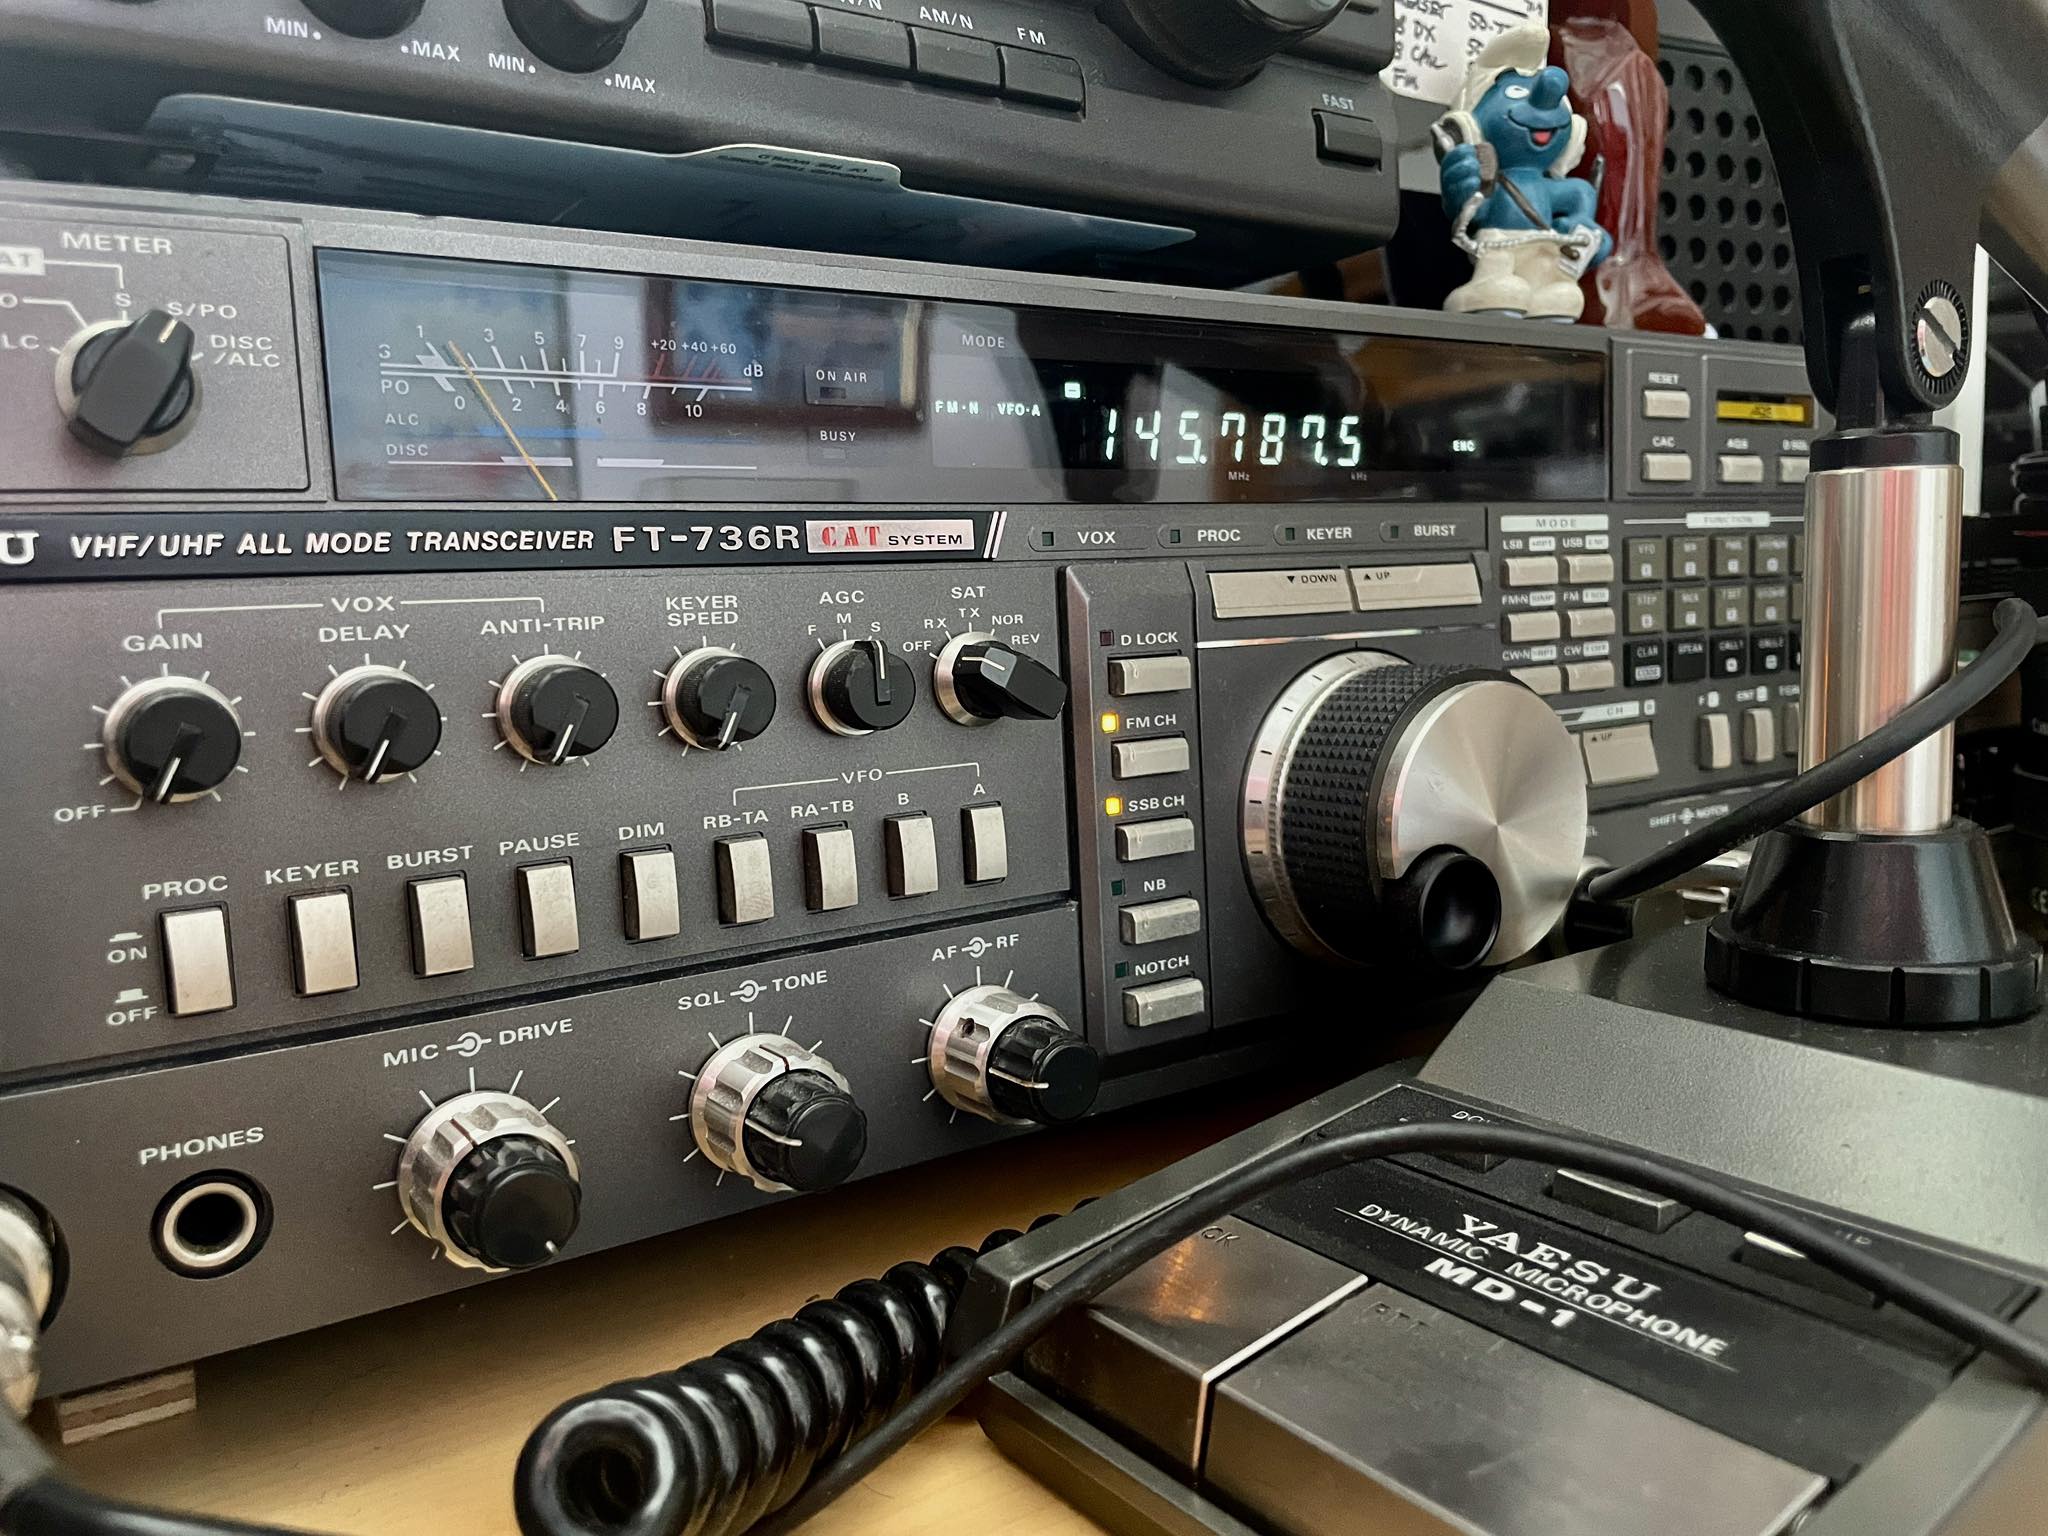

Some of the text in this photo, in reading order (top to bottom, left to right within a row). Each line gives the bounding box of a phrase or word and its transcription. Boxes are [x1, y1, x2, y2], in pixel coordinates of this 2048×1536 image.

[919, 6, 974, 31] AM/N
[265, 16, 309, 38] MIN
[1016, 27, 1046, 46] FM
[412, 40, 460, 62] MAX
[488, 53, 525, 73] MIN
[614, 74, 656, 95] MAX
[1322, 93, 1354, 112] FAST
[61, 231, 174, 255] METER
[116, 292, 132, 307] S
[167, 301, 237, 319] S/PO
[210, 334, 273, 350] DISC
[961, 333, 1005, 348] MODE
[416, 324, 424, 338] 1
[483, 328, 495, 342] 3
[534, 331, 545, 346] 5
[577, 334, 587, 347] 7
[614, 336, 624, 350] 9
[651, 339, 676, 352] +20
[681, 341, 707, 353] +40
[711, 343, 736, 354] +60
[743, 364, 763, 378] dB
[213, 352, 281, 368] /ALC
[815, 369, 867, 383] ON AIR
[1648, 372, 1679, 385] RESET
[381, 379, 703, 418] PO 0 2 4 6 8 10
[385, 413, 419, 426] ALC
[820, 430, 856, 442] BUSY
[386, 443, 429, 457] DISC
[1228, 471, 1250, 481] MHz
[1350, 471, 1368, 481] kHz
[821, 526, 963, 547] CAT SYSTEM
[1077, 531, 1116, 545] VOX
[1197, 529, 1241, 542] PROC
[1306, 527, 1352, 540] KEYER
[1414, 524, 1456, 537] BURST
[70, 525, 799, 559] VHF/UHF ALL MODE TRANSCEIVER FT-736R
[1503, 539, 1523, 550] LSB
[1562, 537, 1584, 548] USB
[1301, 574, 1337, 584] DOWN
[1376, 571, 1390, 580] UP
[819, 590, 865, 605] AGC
[951, 586, 986, 599] SAT
[1563, 591, 1579, 601] FM
[331, 596, 395, 612] VOX
[665, 595, 738, 610] KEYER
[667, 611, 739, 627] SPEED
[836, 613, 851, 623] M
[959, 608, 980, 618] TX
[991, 614, 1023, 625] NOR
[480, 616, 605, 635] ANTI-TRIP
[808, 625, 817, 635] F
[870, 622, 881, 632] S
[924, 618, 947, 629] RX
[319, 624, 410, 643] DELAY
[1011, 633, 1040, 645] REV
[1120, 631, 1179, 646] D LOCK
[123, 632, 203, 652] GAIN
[902, 640, 932, 652] OFF
[1126, 713, 1177, 730] FM CH
[842, 767, 883, 784] VFO
[973, 783, 986, 796] A
[898, 792, 910, 805] B
[1128, 795, 1185, 812] SSB CH
[54, 804, 105, 822] OFF
[790, 800, 855, 819] RA-TB
[703, 809, 769, 830] RB-TA
[618, 822, 665, 841] DIM
[499, 832, 581, 856] PAUSE
[386, 844, 474, 870] BURST
[264, 860, 360, 885] KEYER
[141, 875, 229, 900] PROC
[1143, 878, 1166, 891] NB
[107, 946, 148, 964] ON
[931, 933, 1020, 961] AF RF
[1134, 954, 1190, 977] NOTCH
[677, 970, 828, 1011] SQL TONE
[105, 1006, 158, 1026] OFF
[383, 1017, 573, 1068] MIC DRIVE
[139, 1126, 265, 1165] PHONES
[1455, 1213, 1662, 1300] YAESU
[1357, 1203, 1729, 1358] DYNAMIC MICROPHONE
[1424, 1257, 1578, 1329] MD-1
